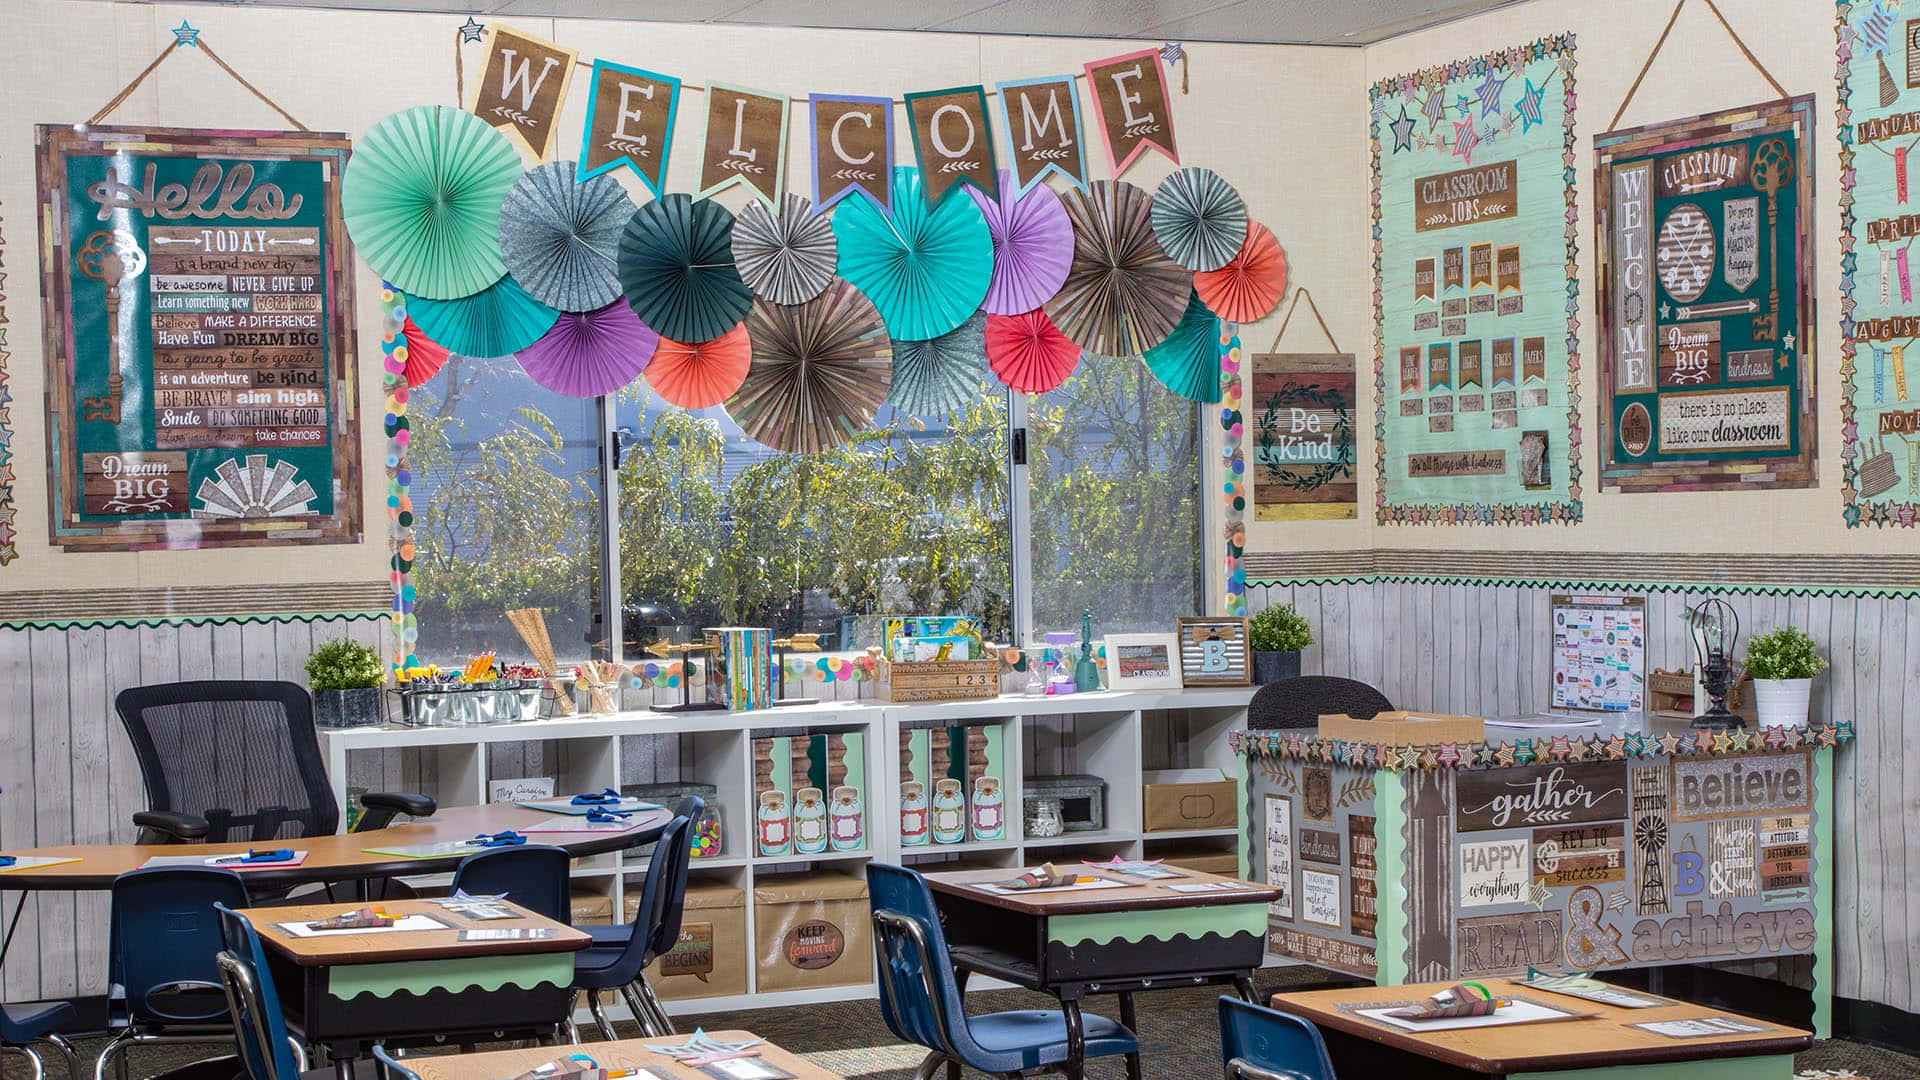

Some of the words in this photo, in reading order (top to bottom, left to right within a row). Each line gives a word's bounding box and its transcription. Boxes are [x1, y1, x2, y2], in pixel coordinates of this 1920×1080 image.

[1664, 152, 1737, 189] CLASSROOM
[87, 162, 303, 221] Hello
[1423, 166, 1509, 204] CLASSROOM
[1449, 198, 1480, 224] JOBS
[201, 230, 267, 252] TODAY
[174, 258, 184, 271] is
[189, 260, 197, 270] a
[200, 256, 239, 270] brand
[243, 261, 270, 271] new
[273, 257, 297, 273] day
[156, 278, 170, 291] be
[174, 281, 225, 291] awesome
[232, 277, 266, 292] NEVER
[272, 276, 295, 292] GIVE
[301, 276, 314, 292] UP
[158, 295, 183, 308] Learn
[185, 295, 229, 311] something
[232, 298, 250, 308] new
[256, 296, 287, 311] WORK
[290, 295, 317, 311] HARD
[156, 313, 197, 329] Believe
[204, 316, 235, 327] MAKE
[238, 316, 247, 327] A
[250, 315, 317, 327] DIFFERENCE
[159, 331, 189, 345] Have
[193, 331, 216, 345] Fun
[224, 332, 284, 346] DREAM
[290, 332, 319, 346] BIG
[1669, 326, 1709, 350] Dream
[184, 353, 227, 369] going
[251, 350, 269, 362] be
[272, 351, 314, 368] great
[1674, 349, 1709, 372] BIG
[1728, 354, 1771, 378] kindness
[160, 372, 169, 384] is
[173, 375, 187, 384] an
[191, 372, 249, 384] adventure
[257, 371, 275, 384] be
[280, 370, 318, 384] kind
[162, 391, 178, 407] BE
[185, 391, 228, 406] BRAVE
[237, 390, 272, 404] aim
[278, 389, 319, 406] high
[161, 409, 202, 426] Smile
[213, 411, 227, 426] DO
[231, 410, 289, 425] SOMETHING
[293, 409, 319, 425] GOOD
[1680, 400, 1708, 419] there
[1710, 401, 1721, 416] is
[1723, 403, 1736, 416] no
[1738, 398, 1767, 420] place
[1290, 408, 1321, 433] Be
[255, 430, 276, 441] take
[280, 429, 321, 440] chances
[1667, 427, 1689, 444] like
[1691, 430, 1710, 443] our
[1712, 419, 1782, 443] classroom
[1278, 433, 1333, 460] Kind
[102, 456, 169, 479] Dream
[113, 479, 170, 499] BIG
[1199, 640, 1229, 672] B
[1682, 762, 1801, 811] Believe
[1463, 767, 1624, 827] gather
[1776, 818, 1793, 828] YOUR
[1560, 830, 1585, 849] KEY
[1594, 829, 1608, 847] TO
[1770, 832, 1800, 844] ATTITUDE
[1463, 845, 1525, 874] HAPPY
[1767, 846, 1807, 859] DETERMINES
[1556, 867, 1609, 882] success
[1672, 852, 1704, 897] B
[1776, 862, 1793, 873] YOUR
[1466, 872, 1523, 902] everything
[1710, 861, 1734, 895] &
[1770, 875, 1803, 888] DIRECTION
[680, 930, 693, 941] the
[797, 925, 825, 938] KEEP
[1564, 886, 1632, 970] &
[1631, 901, 1816, 962] achieve
[800, 936, 825, 945] MOVING
[1307, 936, 1326, 948] COUNT
[1461, 919, 1562, 973] READ
[663, 951, 711, 968] BEGINS
[790, 939, 837, 962] forward
